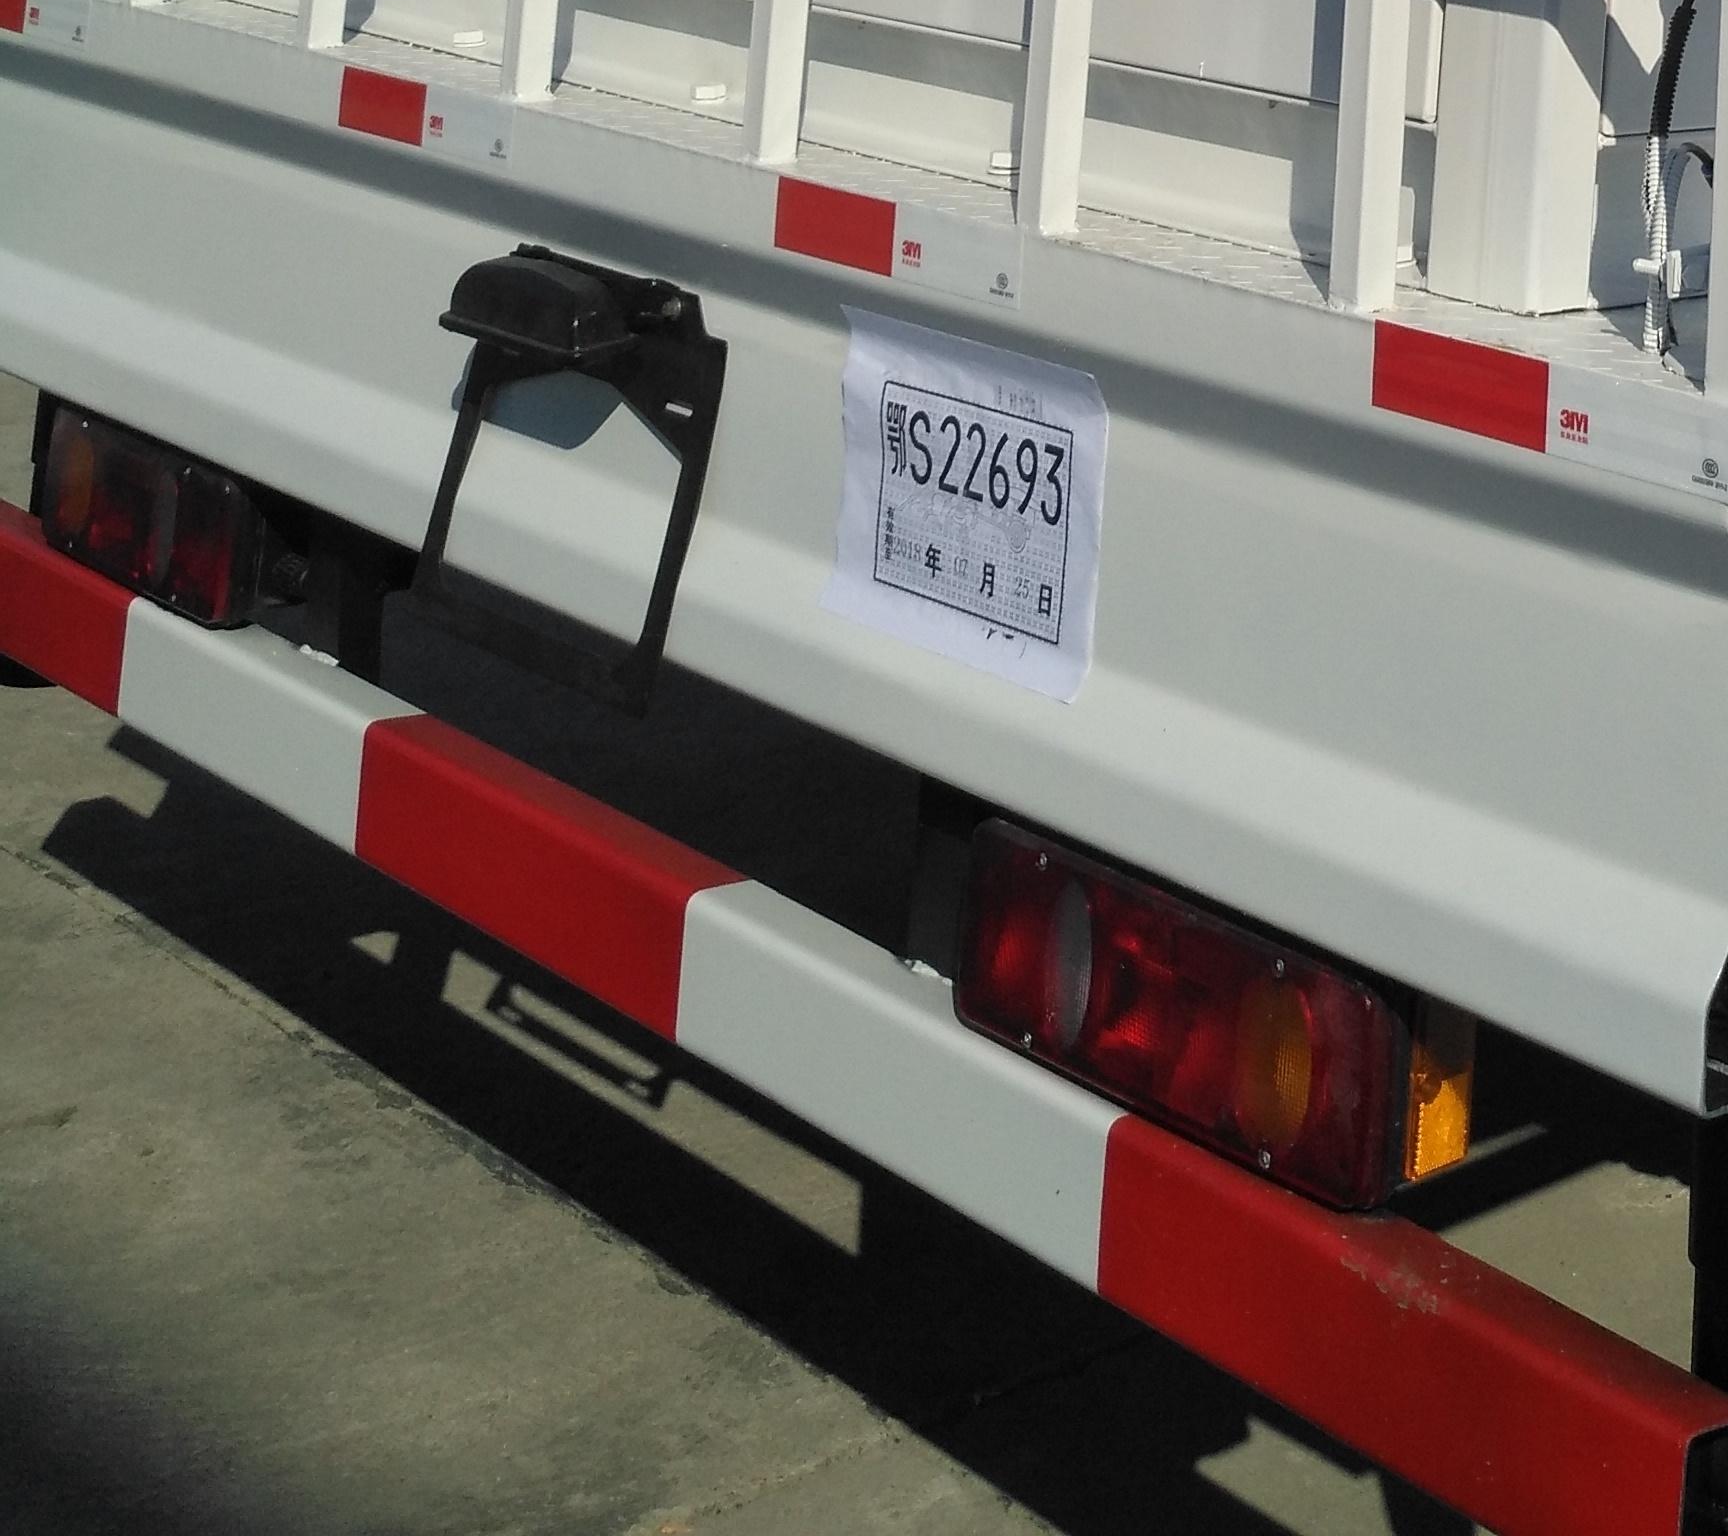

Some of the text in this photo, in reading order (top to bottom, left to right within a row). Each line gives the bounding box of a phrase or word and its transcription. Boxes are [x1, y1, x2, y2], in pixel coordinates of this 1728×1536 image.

[902, 240, 921, 259] 3M
[1560, 409, 1589, 434] 3M
[887, 401, 1064, 526] 鄂S22693
